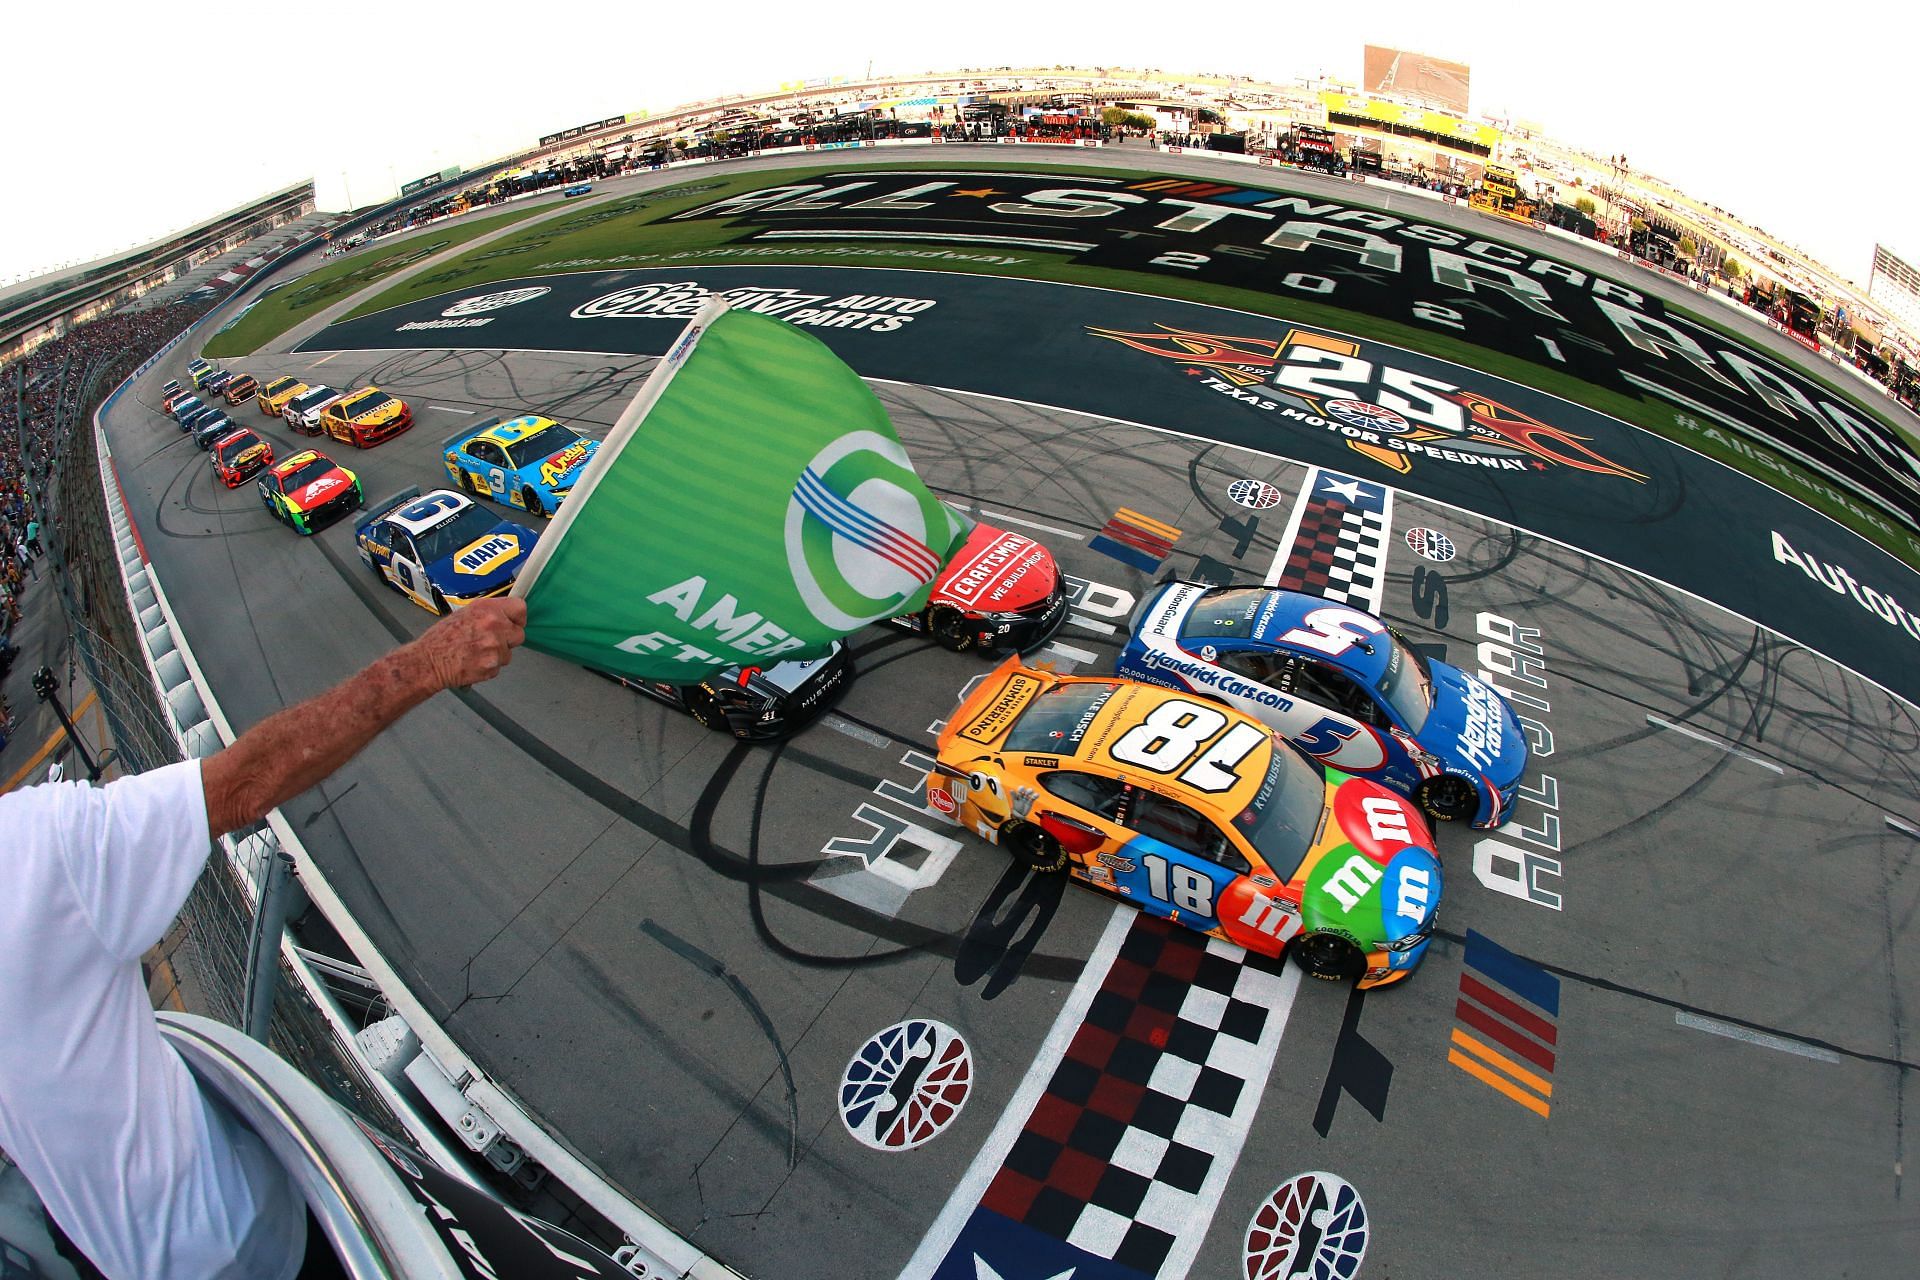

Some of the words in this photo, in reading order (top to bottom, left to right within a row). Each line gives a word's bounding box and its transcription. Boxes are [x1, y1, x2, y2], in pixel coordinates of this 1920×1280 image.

[1300, 141, 1330, 151] AXALTA
[1304, 165, 1329, 174] AXALTA
[670, 181, 960, 219] ALL
[1259, 197, 1643, 312] NASCAR
[821, 294, 936, 314] AUTO
[781, 309, 913, 332] PARTS
[1790, 330, 1815, 347] CRAFTSMAN
[1236, 363, 1276, 378] 1997
[1274, 345, 1465, 433] 25
[354, 400, 396, 422] PENNZOIL
[1200, 376, 1277, 411] TEXAS
[1280, 405, 1380, 441] MOTOR
[1387, 435, 1529, 473] SPEEDWAY
[1468, 423, 1502, 440] 2021
[540, 440, 593, 487] Andy's
[305, 479, 343, 503] AXALTA
[489, 468, 505, 493] 3
[435, 513, 460, 530] ELLIOTT
[459, 538, 515, 570] NAPA
[954, 534, 1030, 595] CRAFTSMAN
[397, 561, 415, 591] 9
[990, 585, 1004, 602] WE
[1003, 567, 1027, 595] BUILD
[1024, 551, 1045, 571] PRIDE
[1041, 595, 1063, 621] CAMRY
[998, 623, 1011, 634] 20
[1276, 607, 1387, 656] 5
[1391, 648, 1400, 674] LARSON
[802, 669, 843, 709] MUSTANG
[1090, 691, 1112, 715] KYLE
[761, 711, 775, 721] 41
[970, 678, 1026, 736] SUMMERING
[1070, 709, 1096, 743] BUSCH
[1293, 716, 1360, 757] 5
[1109, 699, 1269, 793] 18
[1025, 757, 1057, 768] STANLEY
[1445, 766, 1479, 785] GOODYEAR
[1254, 785, 1273, 811] KYLE
[1269, 753, 1282, 787] BUSCH
[931, 789, 953, 808] Rheem
[1362, 797, 1413, 844] m
[1143, 853, 1214, 918] 18
[1321, 855, 1383, 913] m
[1397, 865, 1429, 925] m
[1238, 892, 1303, 943] m
[1315, 927, 1361, 947] GOODYEAR
